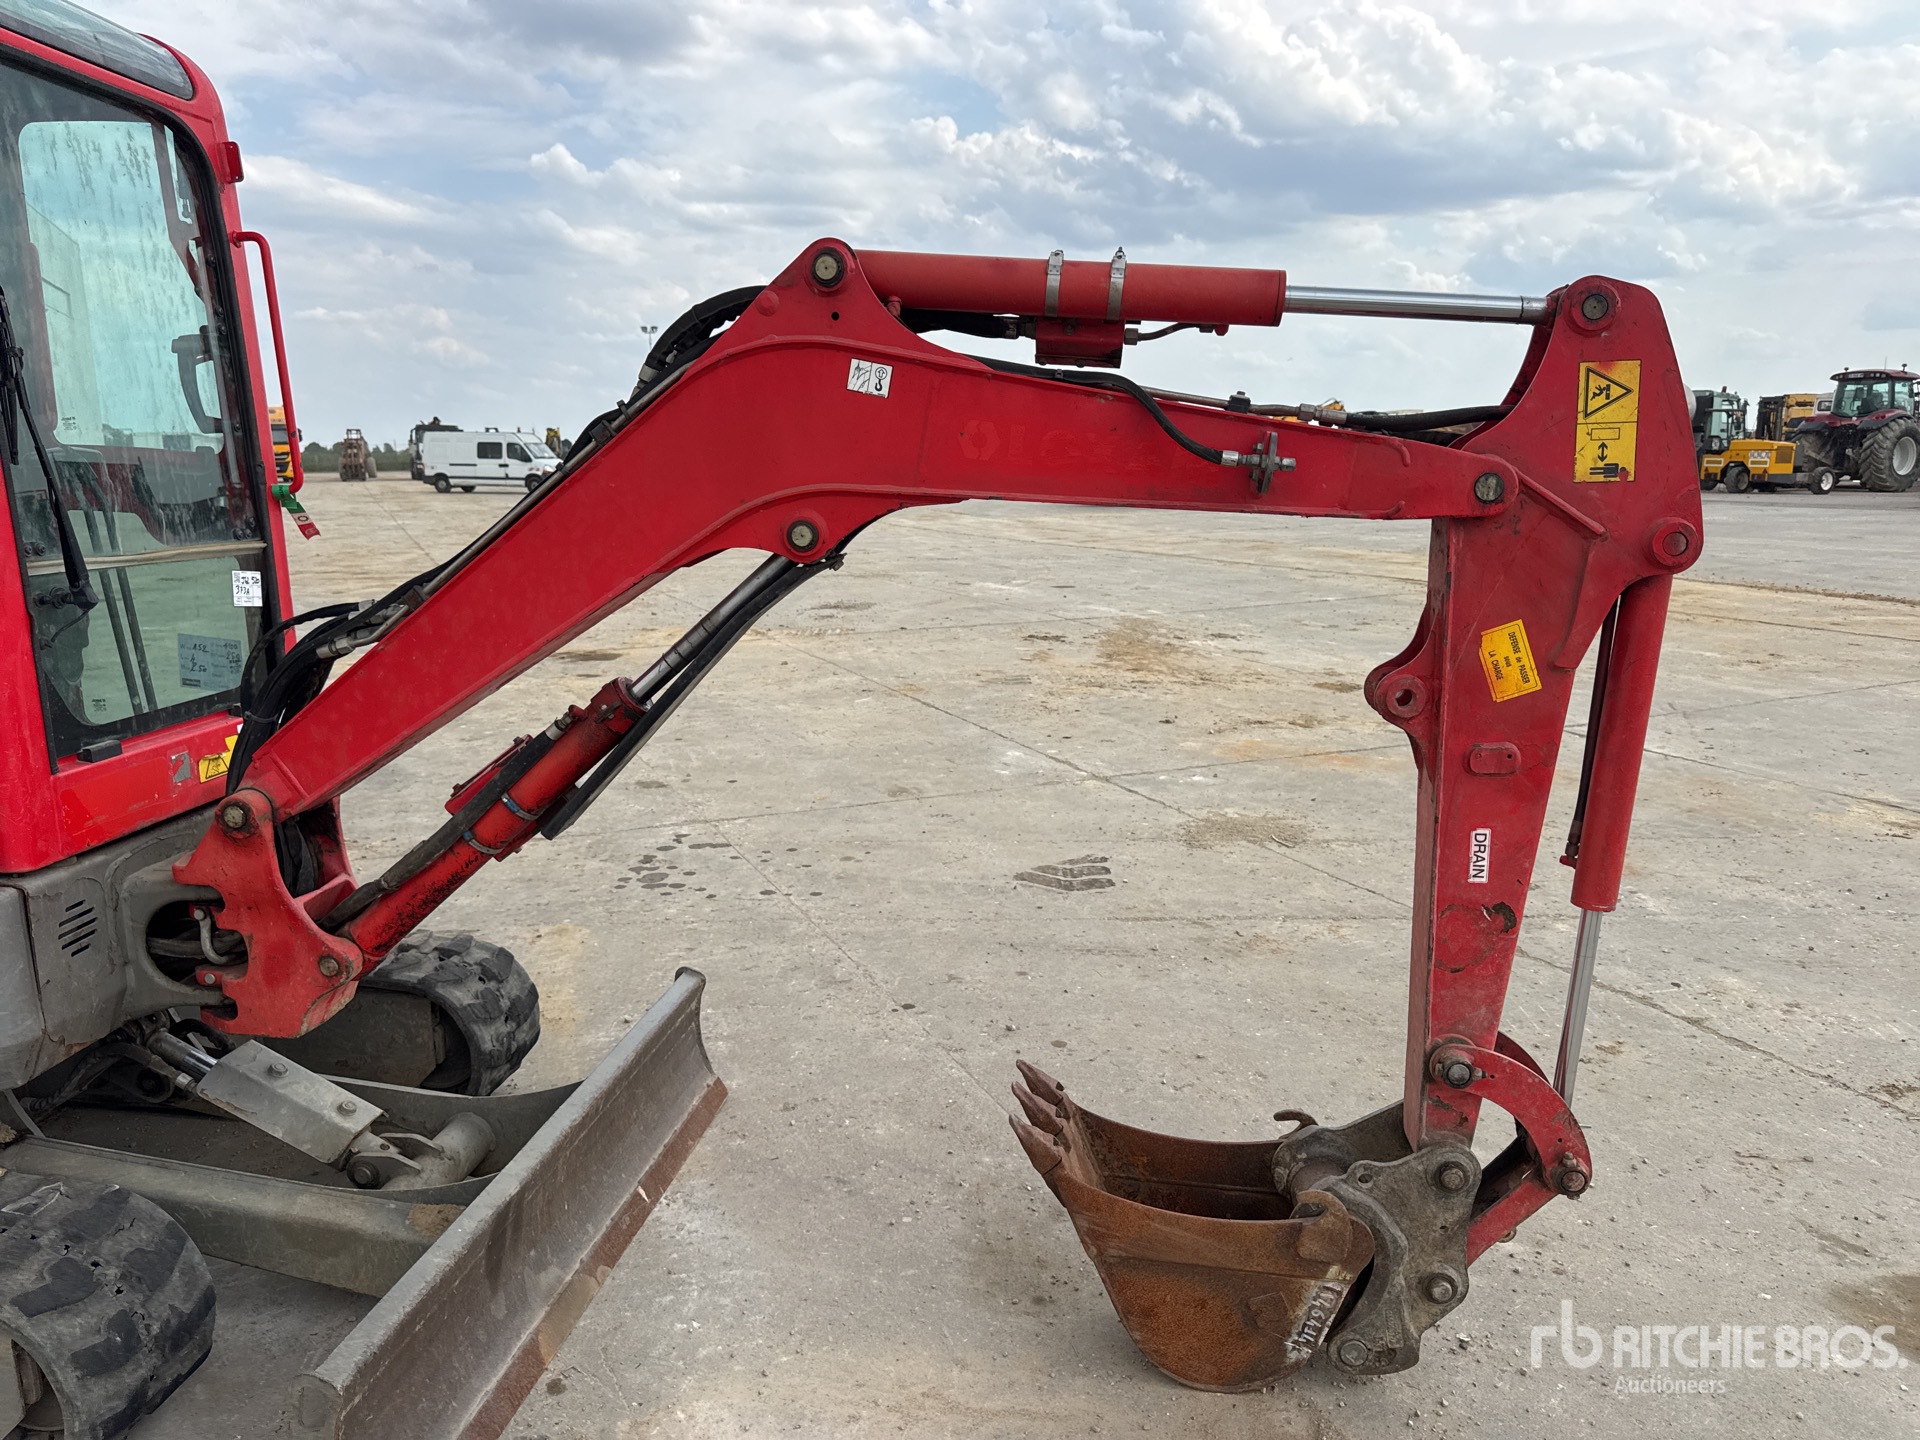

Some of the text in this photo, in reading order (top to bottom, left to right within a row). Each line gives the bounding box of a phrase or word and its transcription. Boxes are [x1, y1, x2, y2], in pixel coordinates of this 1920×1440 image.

[1488, 650, 1504, 680] LA CHARGE
[1508, 631, 1521, 654] DEFENSE
[1518, 664, 1530, 684] PASSER
[1472, 832, 1487, 879] DRAIN
